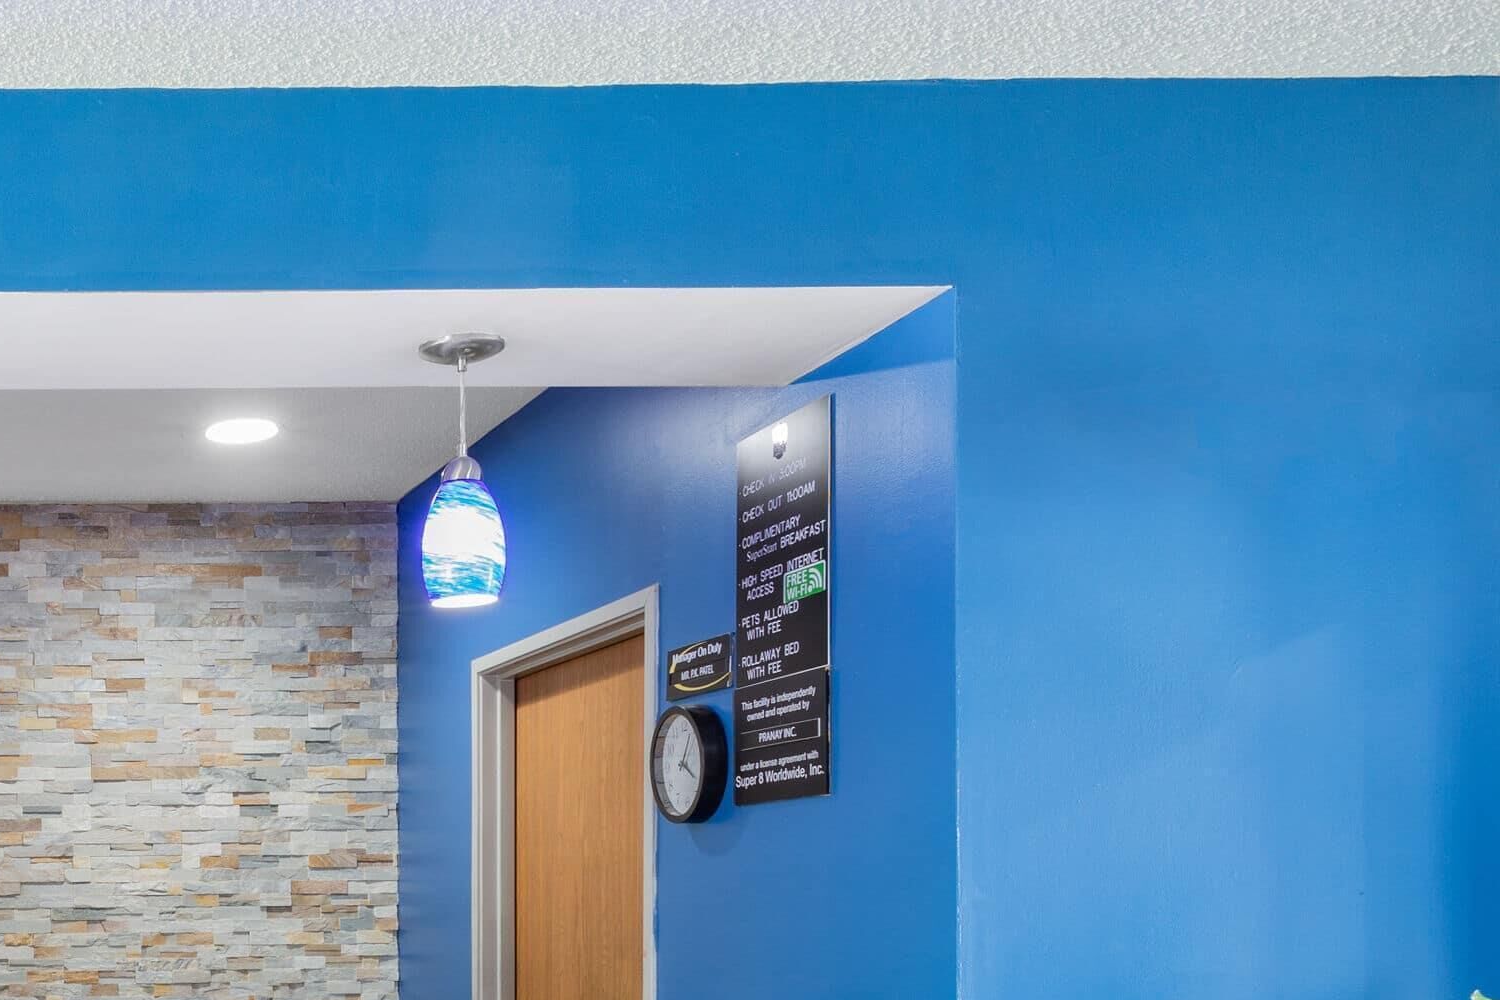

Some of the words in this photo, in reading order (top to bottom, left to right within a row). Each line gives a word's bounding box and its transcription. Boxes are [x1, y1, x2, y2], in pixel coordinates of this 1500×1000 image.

[743, 480, 764, 497] CHECK
[742, 504, 764, 523] CHECK
[768, 495, 783, 511] OUT
[787, 480, 815, 503] 11:00AM
[742, 514, 800, 549] COMPLIMENTARY
[780, 520, 826, 549] BREAKFAST
[742, 574, 757, 589] HIGH
[760, 563, 783, 582] SPEED
[787, 547, 824, 572] INTERNET
[787, 569, 807, 587] FREE
[747, 581, 774, 601] ACCESS
[787, 582, 807, 600] WI-FI
[742, 613, 760, 629] PETS
[764, 600, 799, 621] ALLOWED
[747, 626, 765, 641] WITH
[767, 619, 782, 635] FEE
[672, 650, 697, 664] Manager
[697, 646, 707, 657] On
[707, 641, 722, 655] Duty
[742, 646, 781, 668] ROLLAWAY
[784, 641, 800, 656] BED
[699, 664, 714, 676] PATEL
[747, 666, 765, 681] WITH
[767, 660, 782, 675] FEE
[741, 701, 753, 711] This
[753, 696, 770, 709] facility
[770, 695, 776, 704] is
[776, 685, 816, 702] independently
[747, 709, 765, 721] owned
[765, 707, 776, 717] and
[776, 702, 801, 716] operated
[801, 699, 810, 711] by
[758, 728, 783, 743] PRANAY
[783, 726, 797, 738] INC.
[740, 762, 755, 772] under
[759, 758, 778, 768] license
[778, 752, 807, 767] agreement
[806, 749, 819, 760] with
[735, 775, 758, 790] Super
[758, 771, 764, 785] 8
[764, 765, 808, 783] Worldwide,
[809, 763, 825, 776] Inc.
